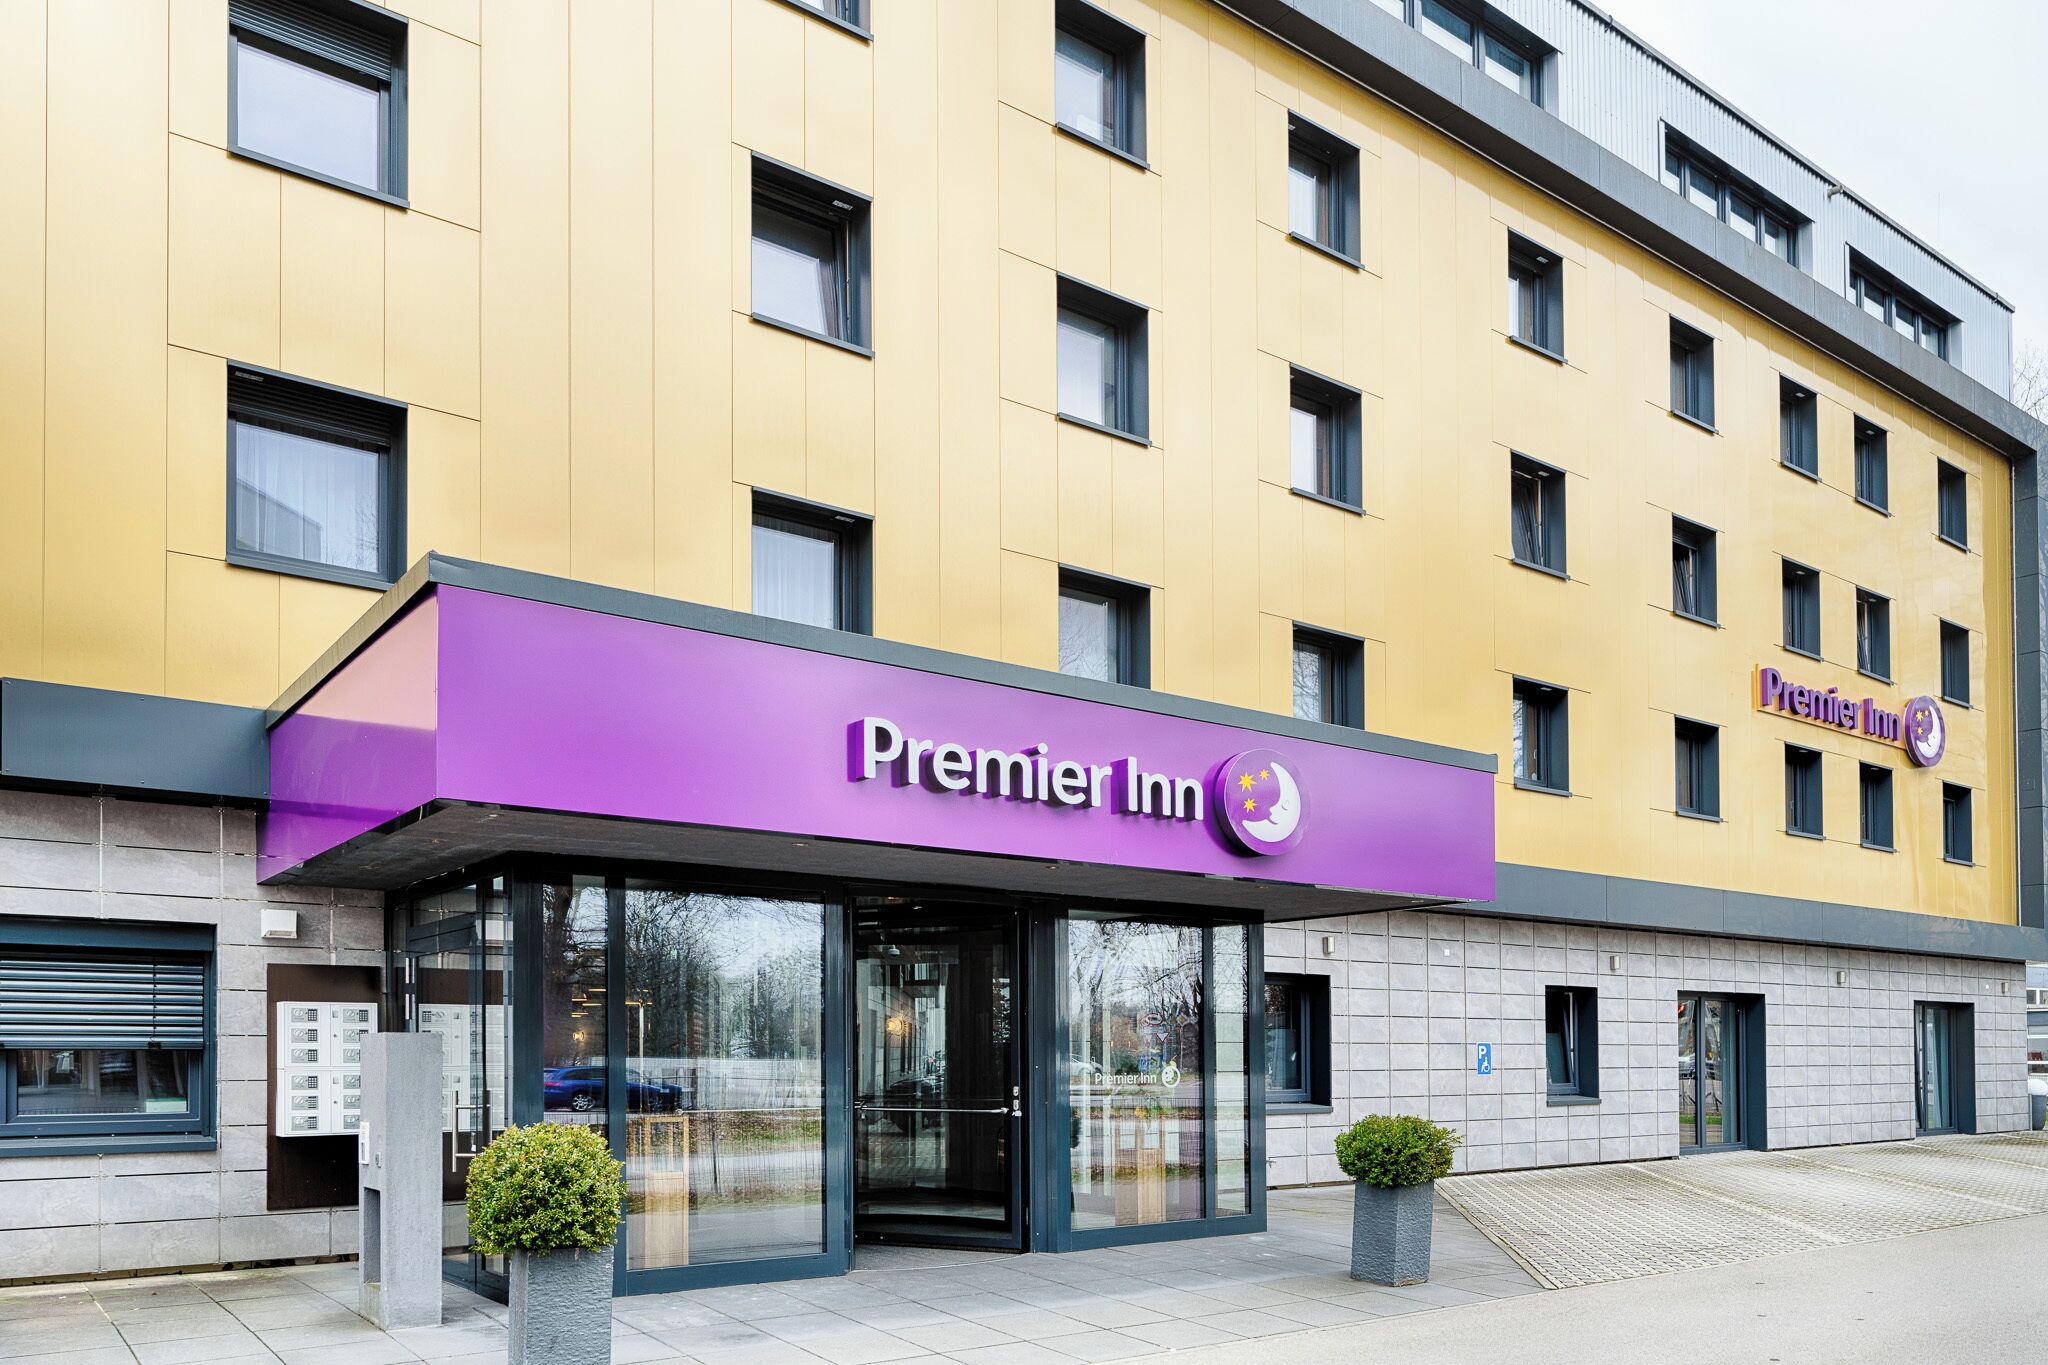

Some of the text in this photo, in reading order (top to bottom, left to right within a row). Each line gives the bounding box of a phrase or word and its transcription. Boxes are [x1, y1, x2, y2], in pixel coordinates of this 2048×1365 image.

[1761, 667, 1901, 742] Premier Inn
[860, 716, 1204, 821] Premier Inn
[1479, 1045, 1487, 1059] P
[1095, 1072, 1157, 1085] Premier Inn
